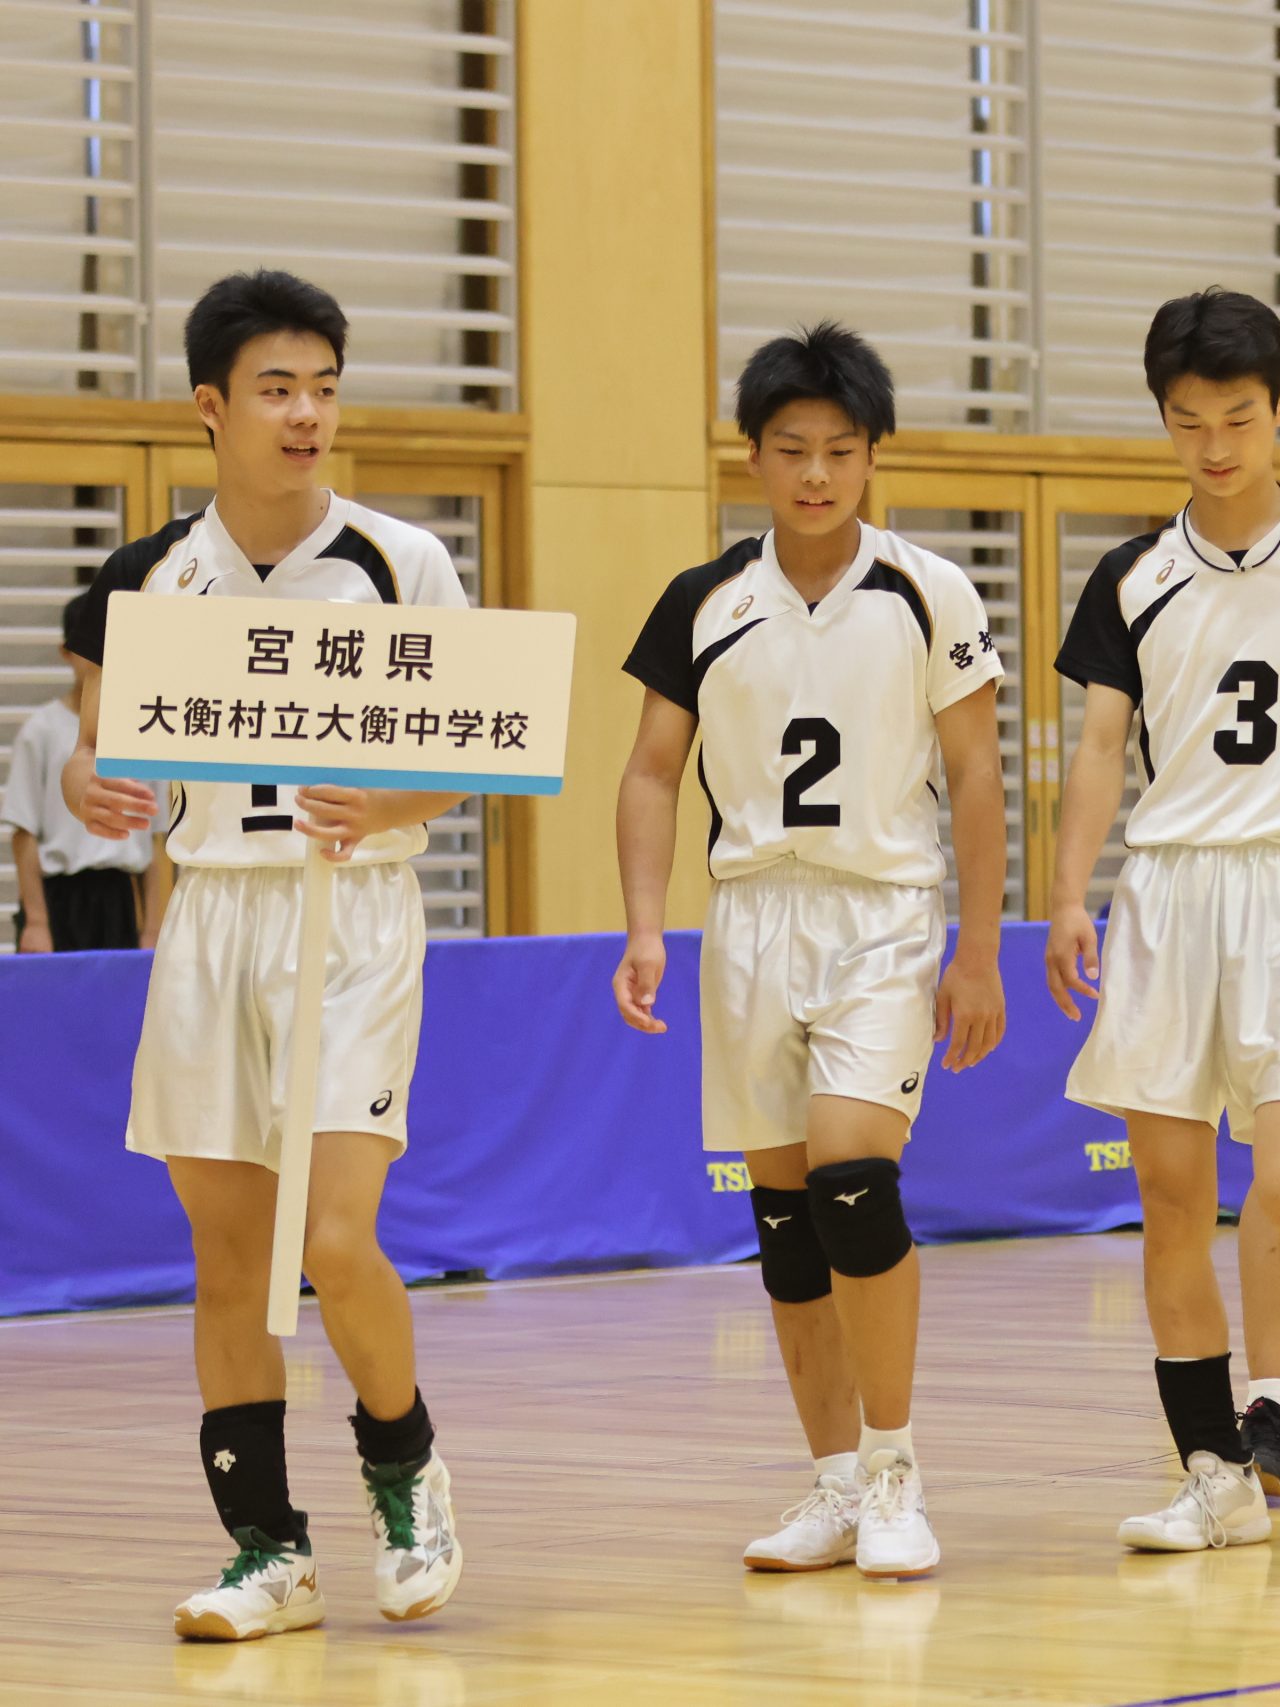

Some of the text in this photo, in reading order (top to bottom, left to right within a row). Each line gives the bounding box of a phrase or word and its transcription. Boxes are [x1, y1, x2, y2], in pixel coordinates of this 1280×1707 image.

[247, 625, 433, 682] 宮城県
[138, 695, 529, 750] 大衡村立大衡中学校
[1213, 660, 1279, 765] 3
[780, 717, 841, 828] 2
